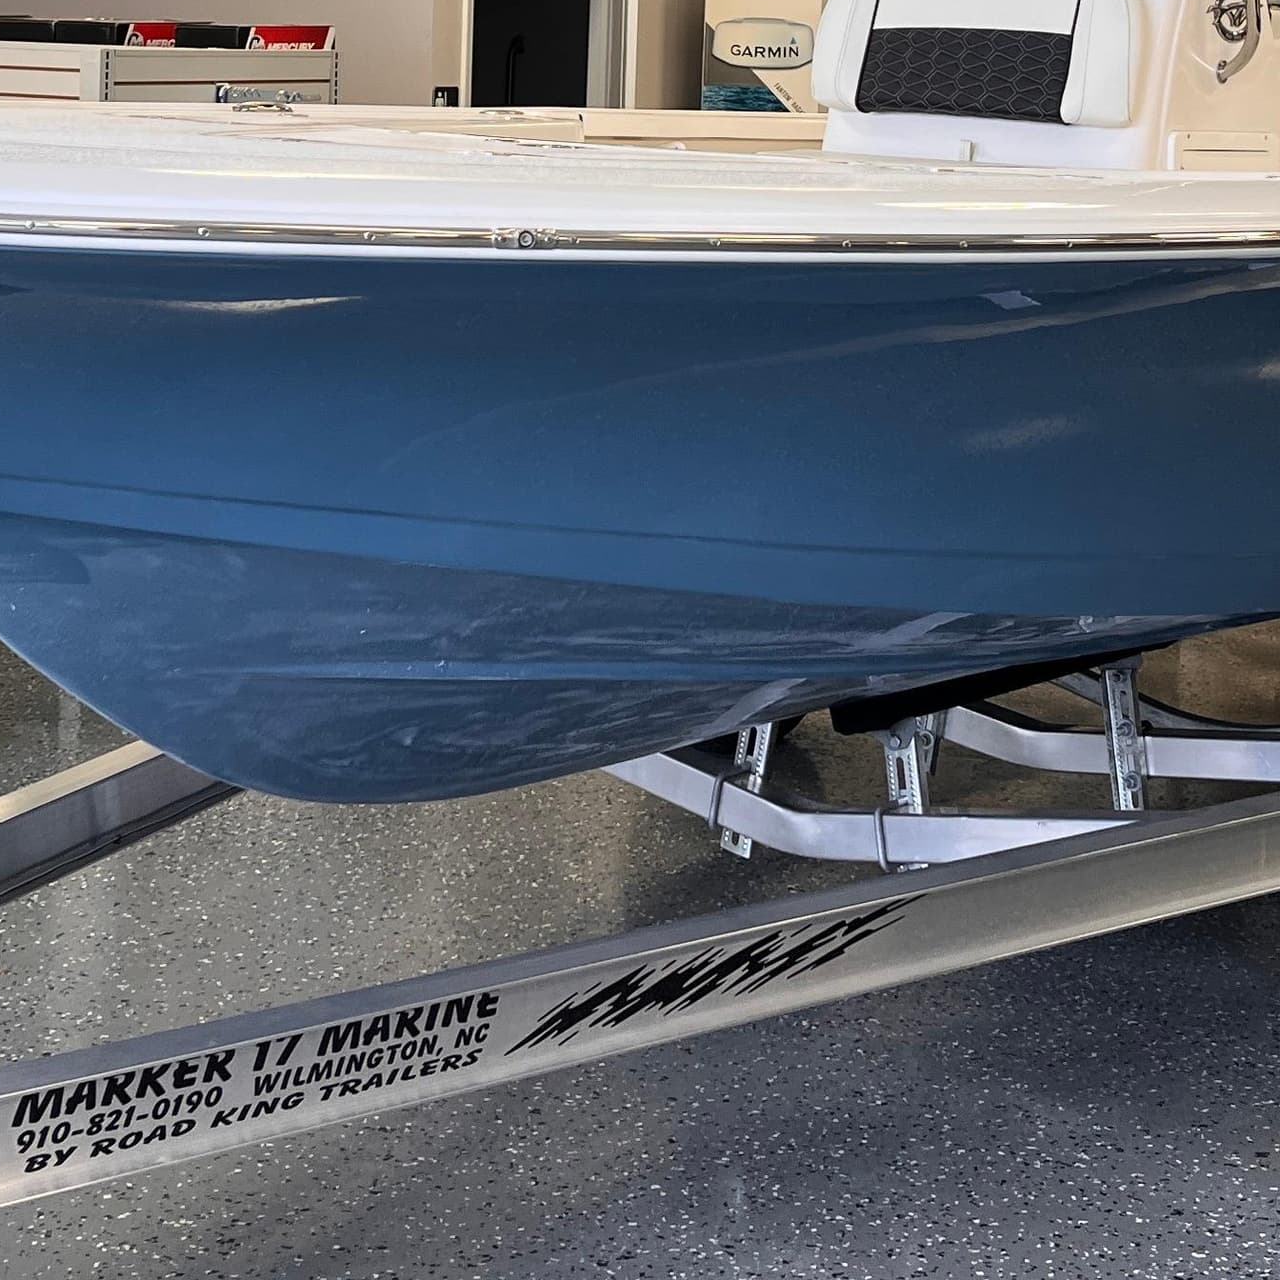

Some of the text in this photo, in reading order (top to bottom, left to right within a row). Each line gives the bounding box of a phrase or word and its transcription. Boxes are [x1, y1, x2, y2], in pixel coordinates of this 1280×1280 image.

[730, 45, 799, 58] GARMIN
[11, 992, 499, 1128] MARKER 17 MARINE
[17, 1023, 490, 1154] 910-821-0190 WILMINGTON, NC
[24, 1048, 484, 1173] BY ROAD KING TRAILERS
